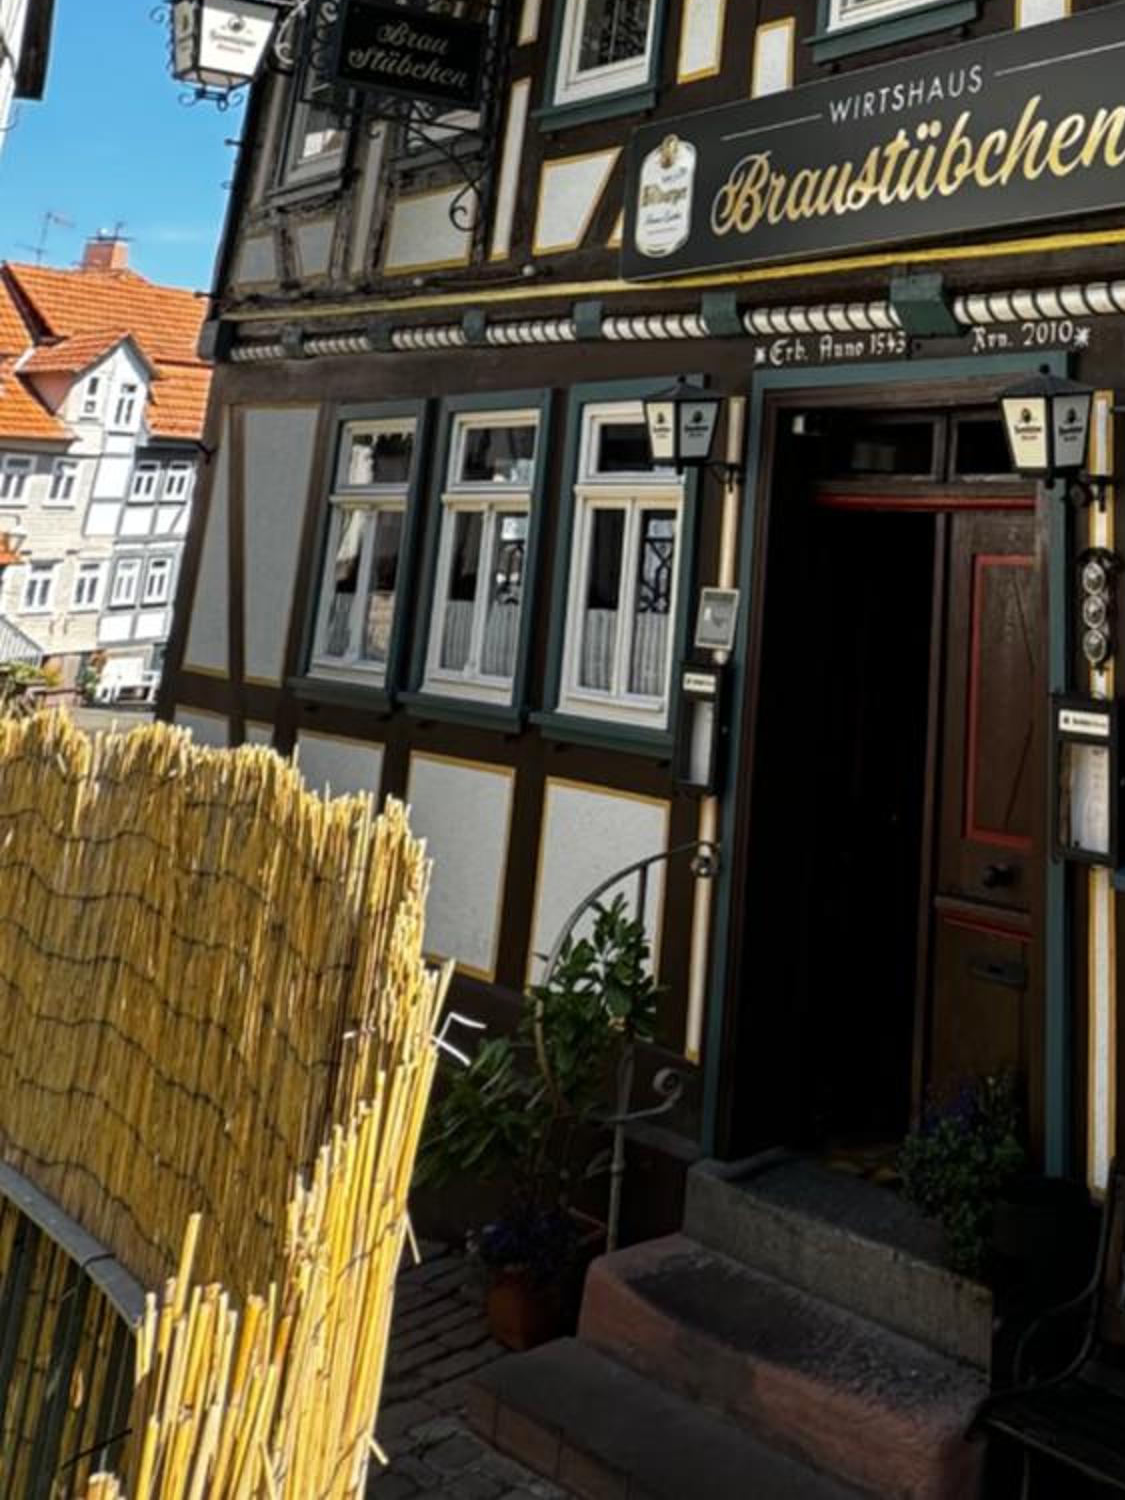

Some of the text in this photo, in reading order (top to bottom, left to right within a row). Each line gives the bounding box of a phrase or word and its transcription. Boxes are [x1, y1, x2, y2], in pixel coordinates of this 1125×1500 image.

[378, 21, 449, 56] Brau
[828, 64, 984, 125] WIRTSHAUS
[819, 334, 865, 361] Anno
[1021, 320, 1074, 346] 2010
